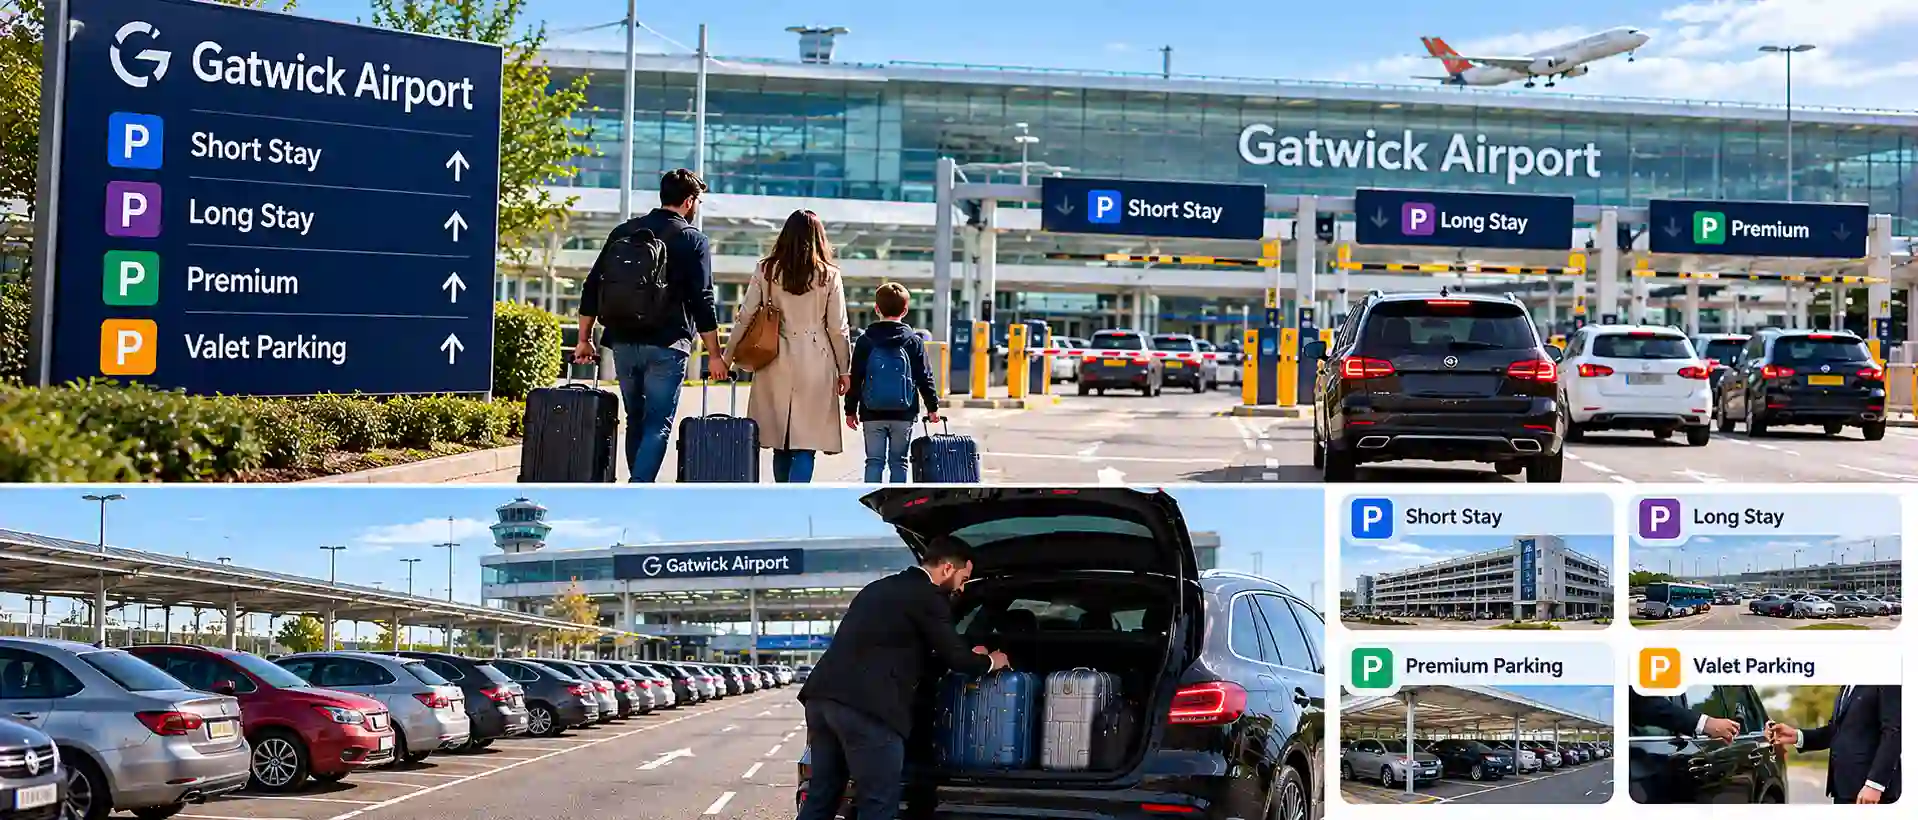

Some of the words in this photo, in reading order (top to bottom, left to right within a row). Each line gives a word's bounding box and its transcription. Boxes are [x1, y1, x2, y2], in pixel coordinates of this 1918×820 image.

[193, 41, 345, 96] Gatwick
[355, 62, 473, 112] Airport
[125, 124, 149, 158] P
[191, 132, 261, 161] Short
[269, 139, 321, 171] Stay
[1239, 124, 1429, 171] Gatwick
[1440, 133, 1601, 184] Airport
[122, 192, 147, 227] P
[190, 199, 252, 232] Long
[261, 203, 314, 235] Stay
[1097, 197, 1113, 218] P
[1128, 199, 1179, 218] Short
[1183, 202, 1222, 223] Stay
[1411, 209, 1427, 229] P
[1442, 212, 1484, 233] Long
[1489, 213, 1528, 234] Stay
[1703, 217, 1717, 238] P
[1732, 220, 1809, 237] Premium
[120, 261, 145, 296] P
[188, 266, 297, 293] Premium
[117, 330, 142, 365] P
[184, 334, 250, 359] Valet
[258, 335, 346, 364] Parking
[666, 556, 728, 573] Gatwick
[732, 555, 789, 574] Airport
